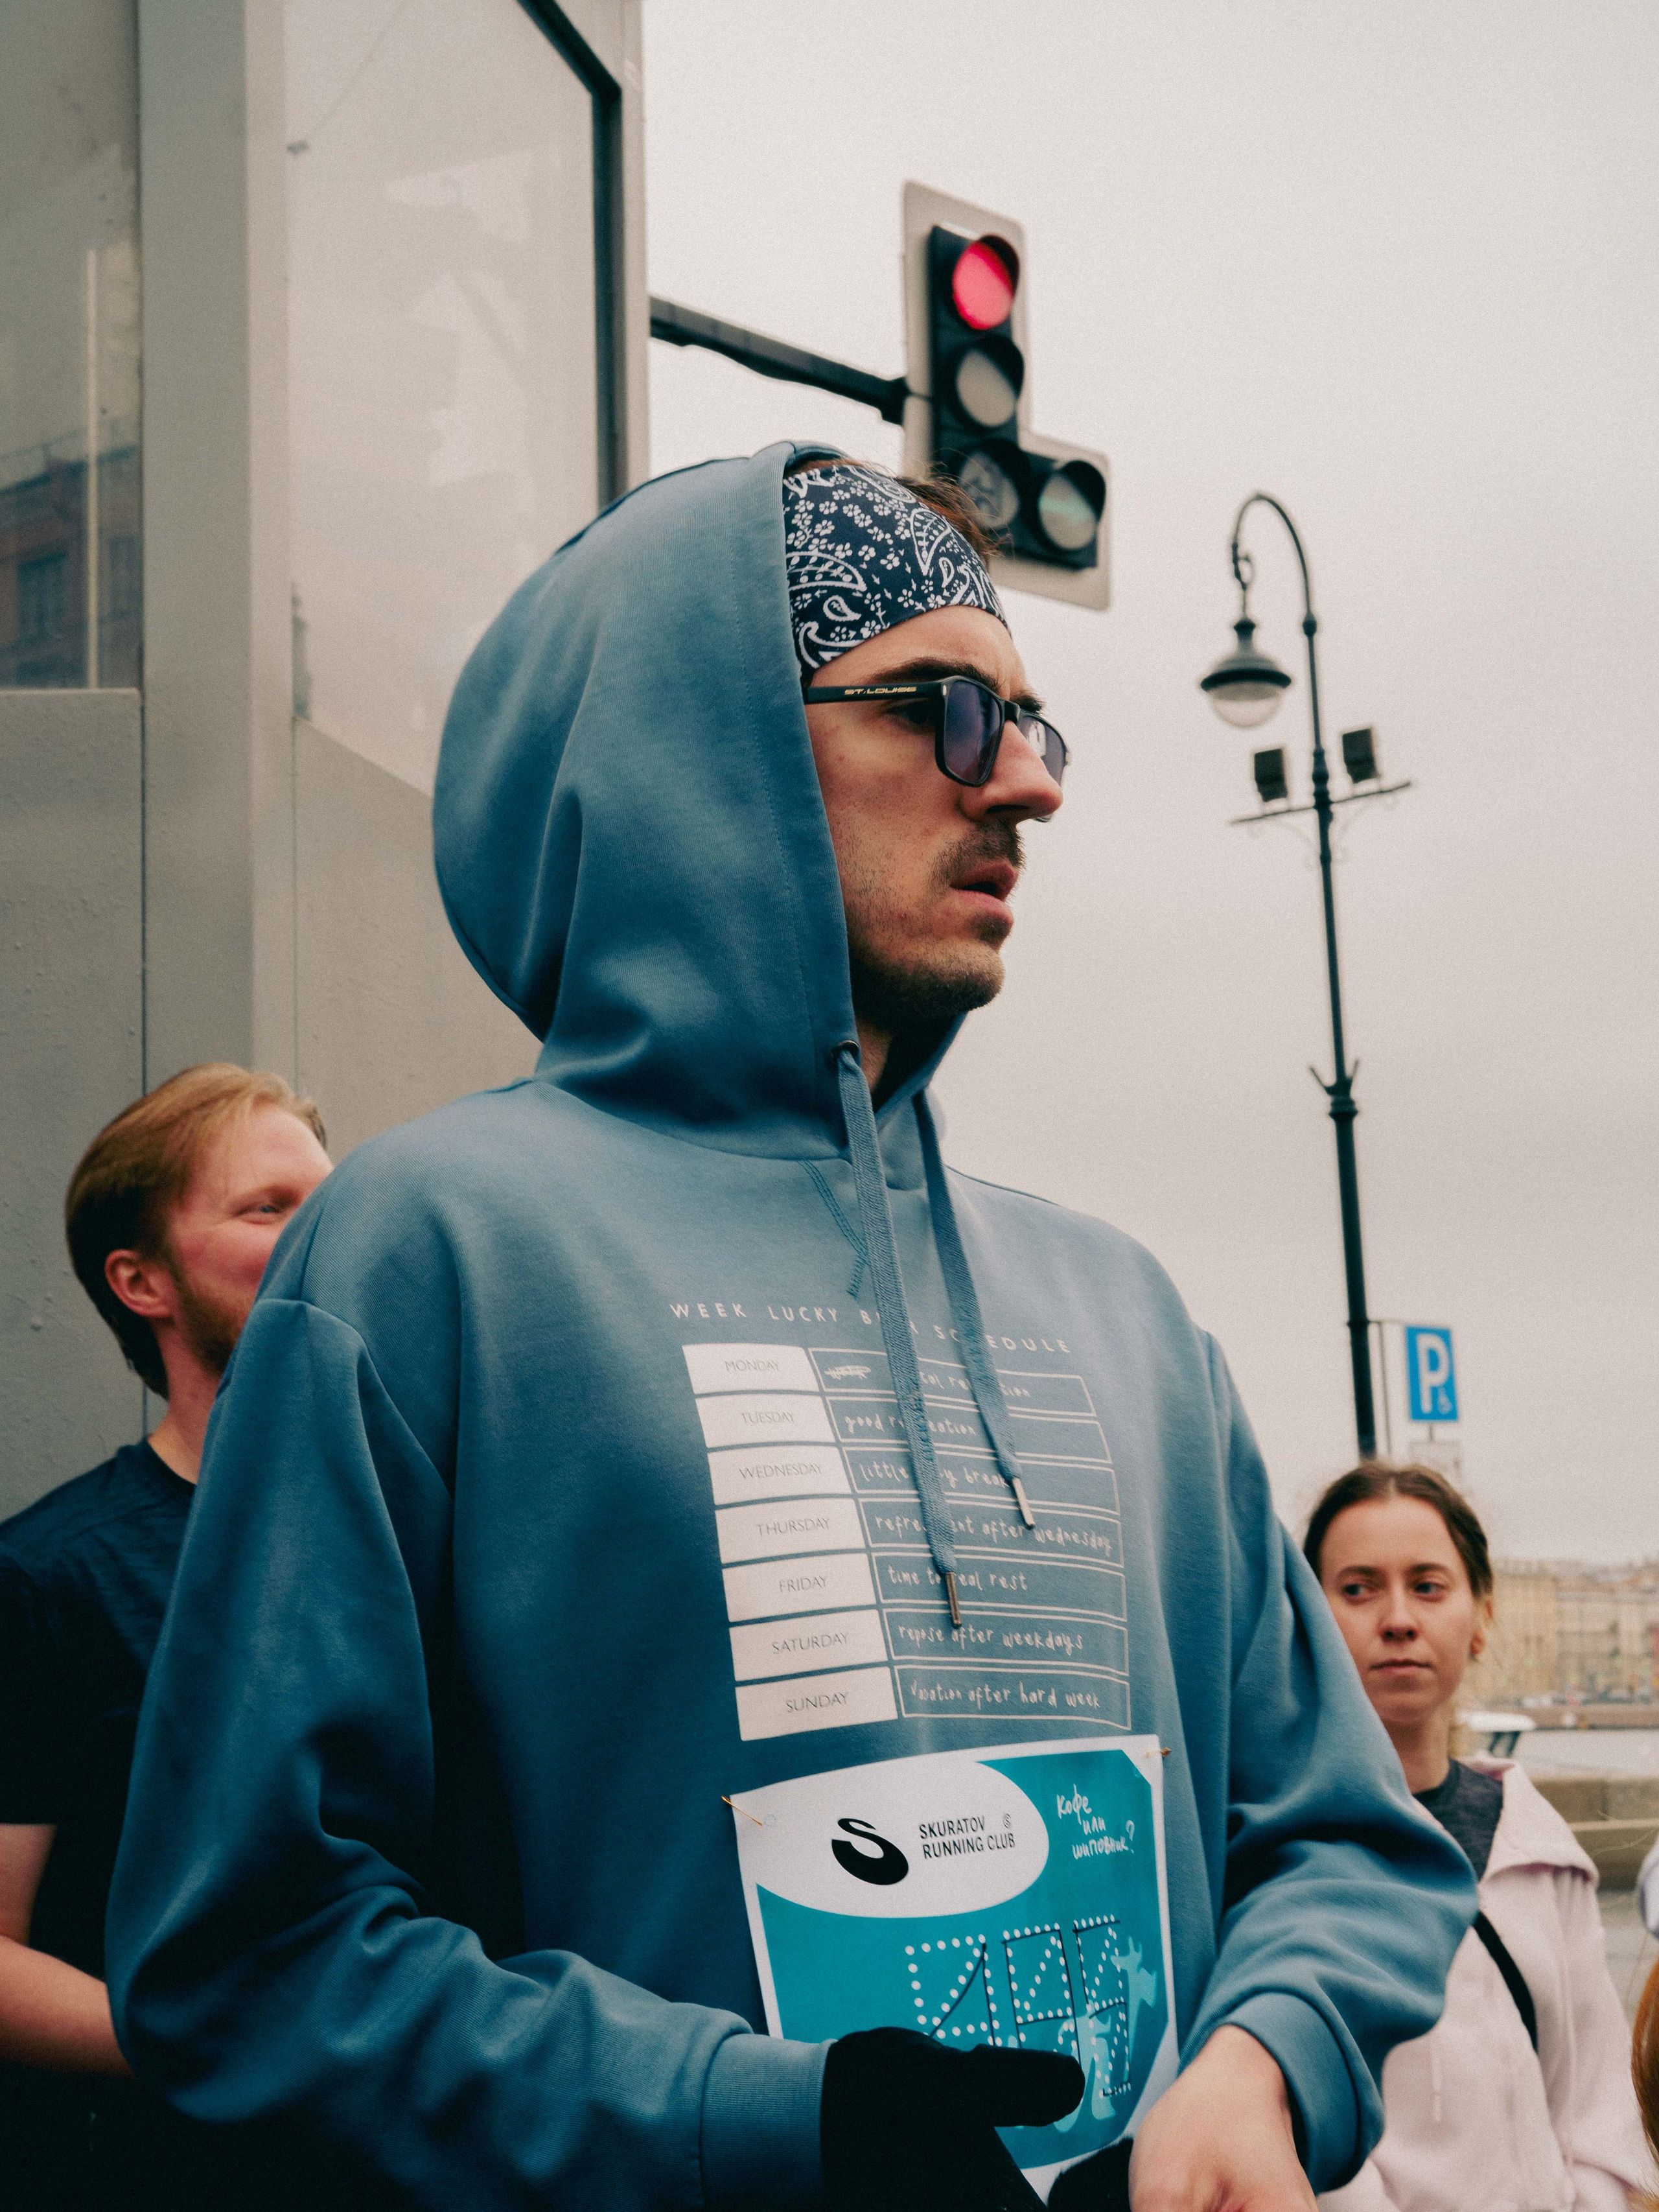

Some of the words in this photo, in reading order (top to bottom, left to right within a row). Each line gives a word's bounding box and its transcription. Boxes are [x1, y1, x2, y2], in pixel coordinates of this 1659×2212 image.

[669, 1303, 746, 1319] WEEK
[767, 1306, 837, 1322] LUCKY
[933, 1325, 1070, 1353] SCEDULE
[725, 1359, 779, 1372] MONDAY
[1416, 1333, 1450, 1414] P
[741, 1411, 795, 1424] TUESDAY
[844, 1414, 885, 1434] good
[739, 1463, 822, 1479] WEDNESDAY
[860, 1460, 909, 1482] little
[962, 1465, 1010, 1489] break
[758, 1517, 830, 1536] THURSDAY
[982, 1519, 1025, 1544] after
[779, 1576, 828, 1592] FRIDAY
[888, 1565, 920, 1585] time
[989, 1572, 1028, 1590] rest
[772, 1632, 849, 1655] SATURDAY
[951, 1624, 995, 1650] after
[1003, 1630, 1084, 1657] weekdays
[786, 1692, 849, 1713] SUNDAY
[968, 1682, 1011, 1711] after
[1019, 1681, 1058, 1709] hard
[1065, 1691, 1101, 1710] week
[1056, 1783, 1093, 1826] Кофе
[919, 1815, 985, 1839] SKURATOV
[1082, 1815, 1107, 1836] или
[922, 1837, 984, 1859] RUNNING
[987, 1832, 1015, 1850] CLUB
